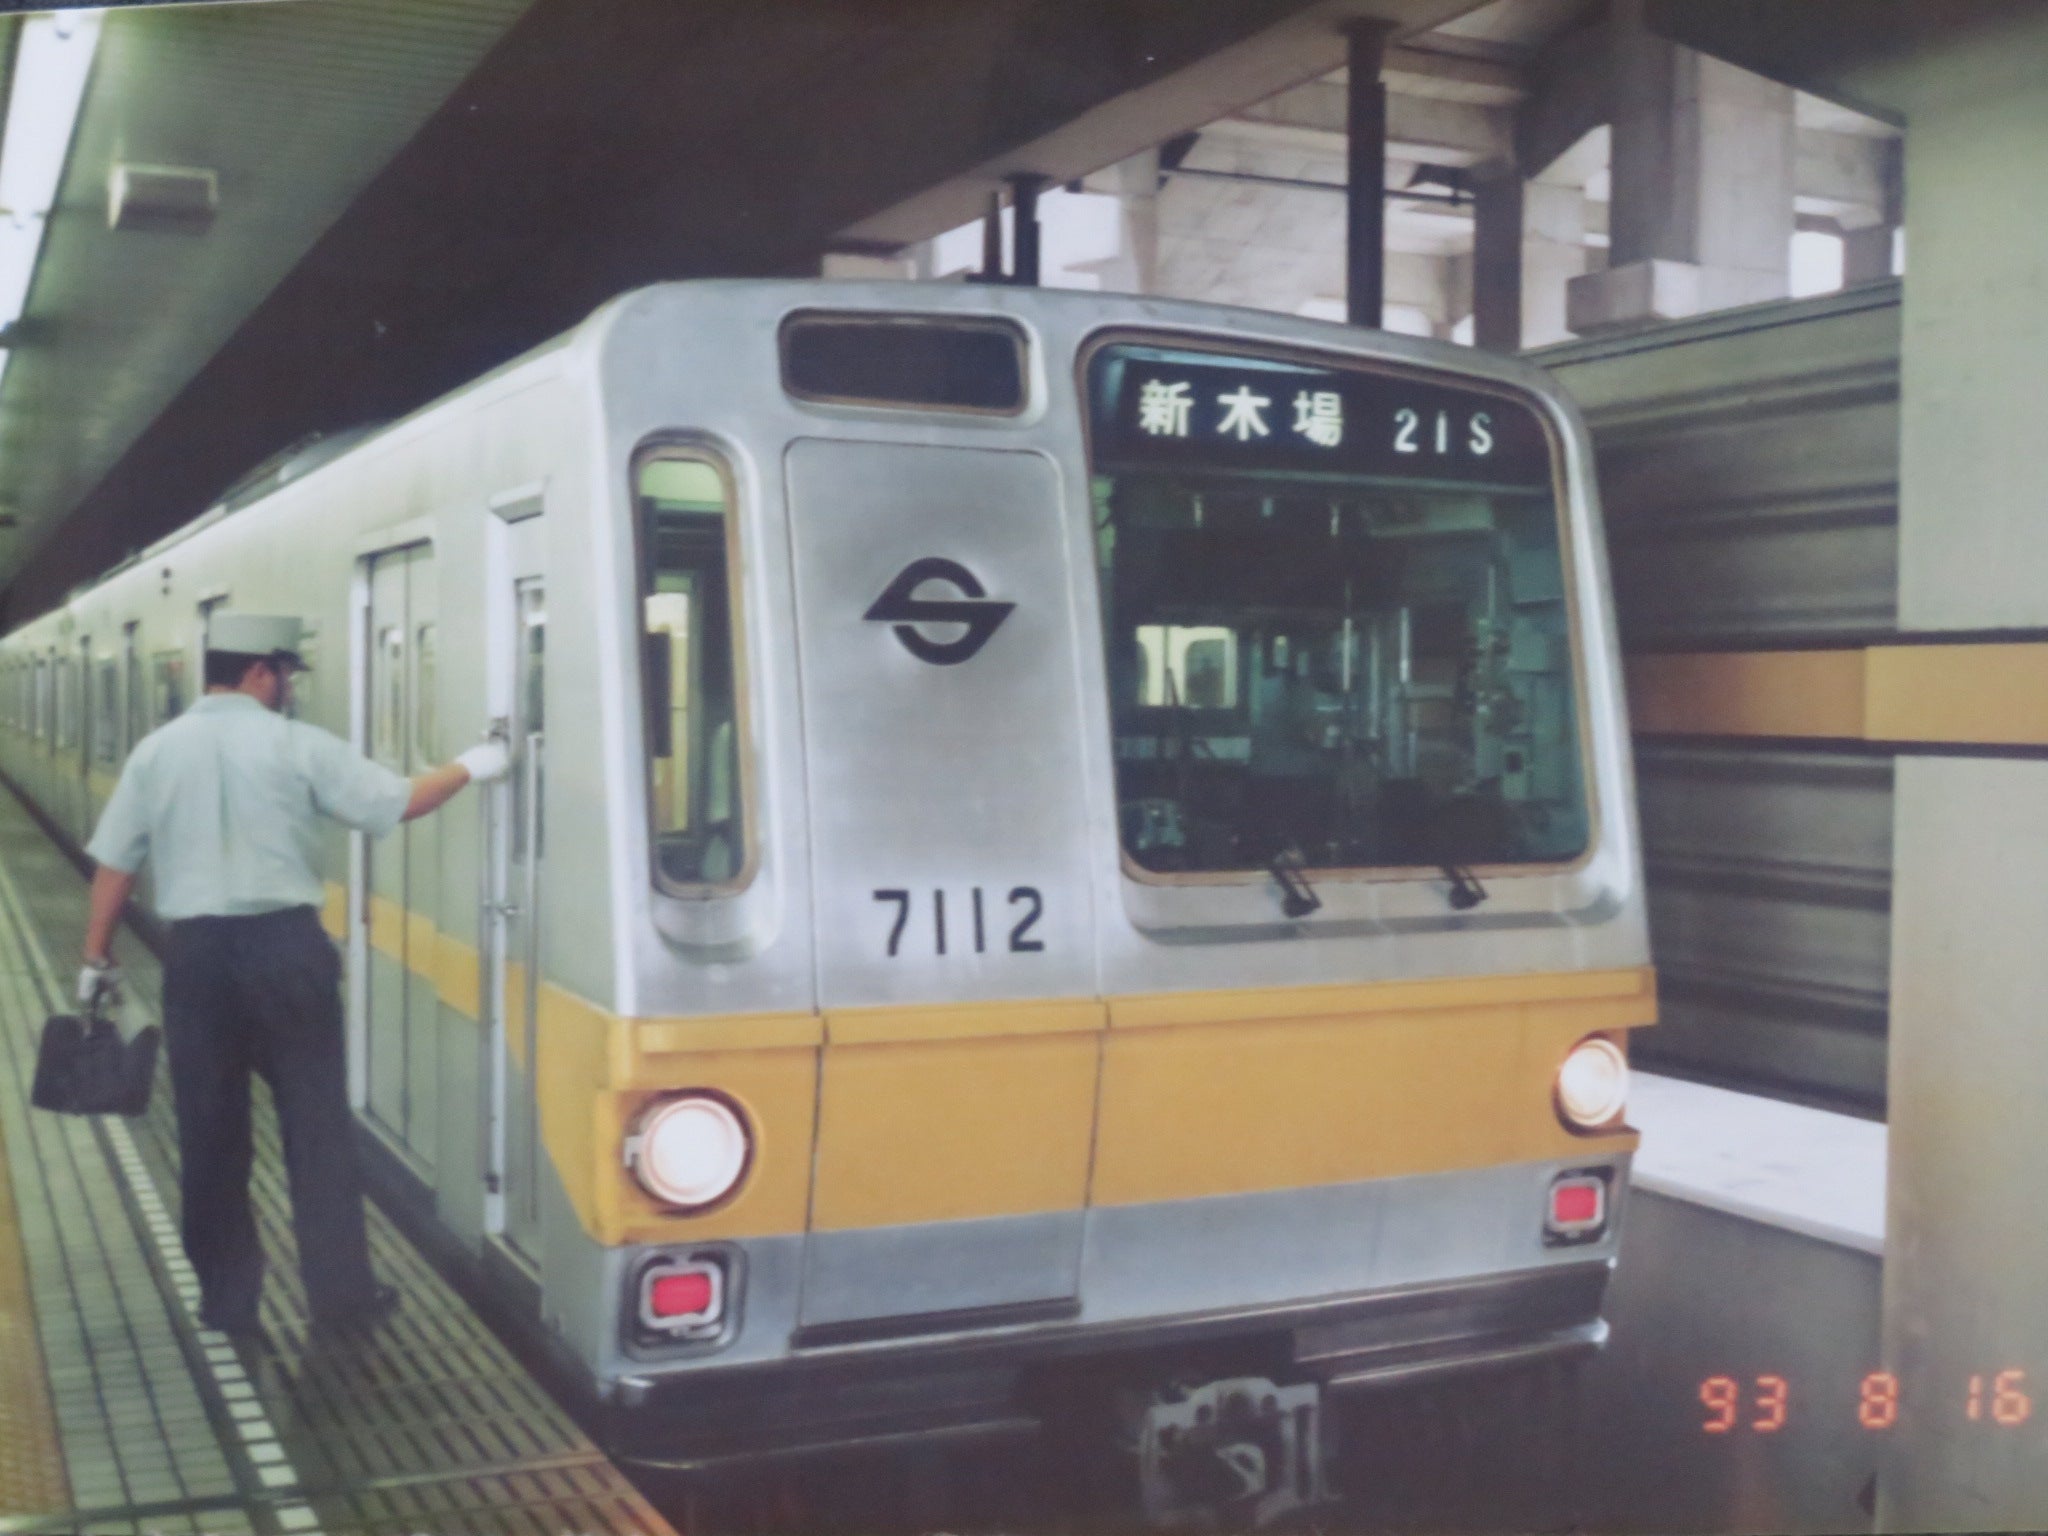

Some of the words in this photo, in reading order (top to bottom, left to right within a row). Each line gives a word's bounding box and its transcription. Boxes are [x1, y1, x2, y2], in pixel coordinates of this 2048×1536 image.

[1138, 379, 1344, 448] 新木場
[1393, 408, 1495, 455] 21S
[872, 886, 1045, 957] 7112
